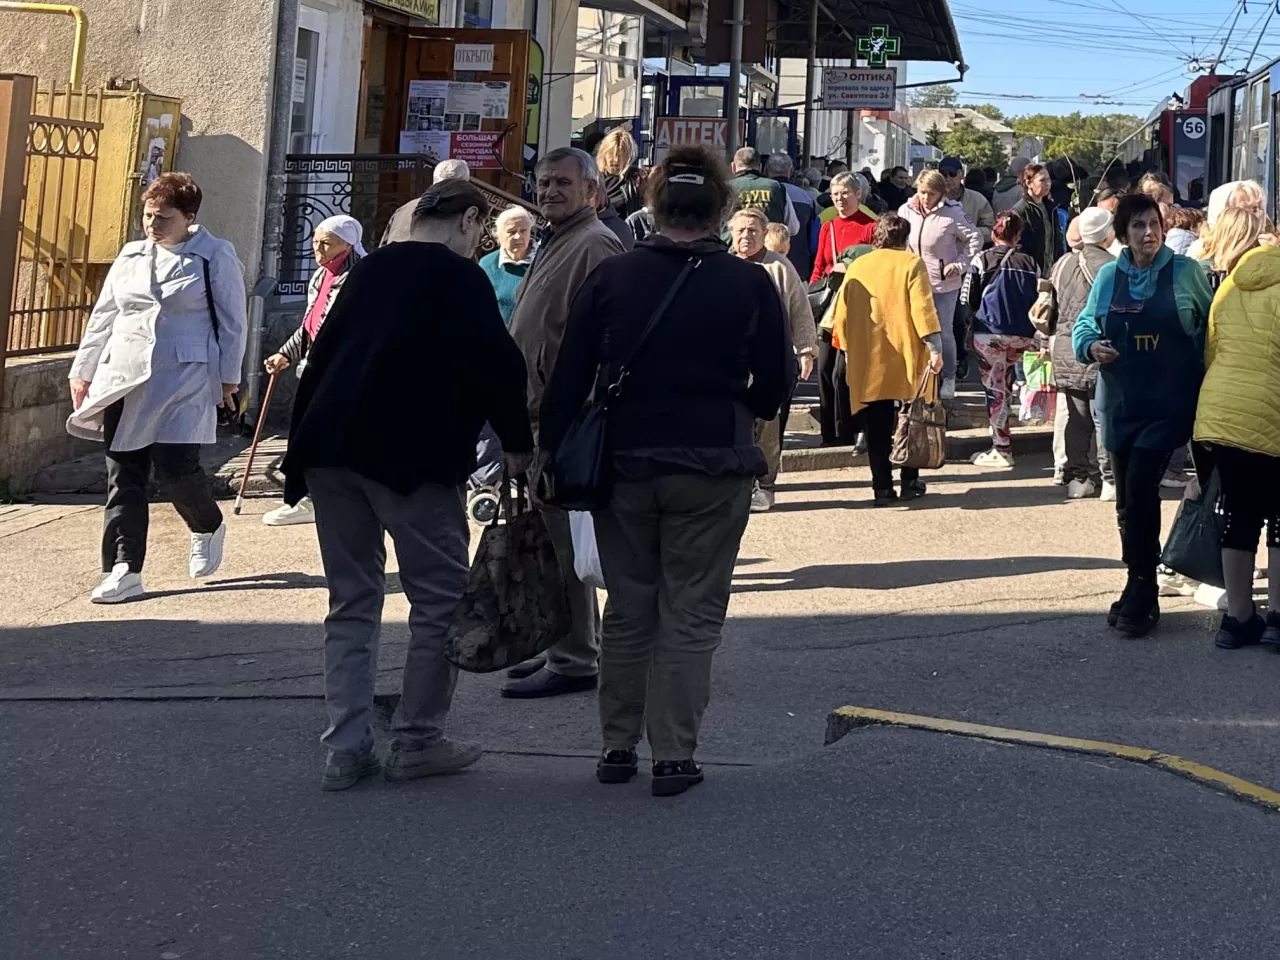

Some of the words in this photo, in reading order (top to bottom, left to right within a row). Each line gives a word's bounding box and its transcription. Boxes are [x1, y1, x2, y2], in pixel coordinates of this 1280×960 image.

[455, 49, 493, 63] ОТКРЫТО
[849, 73, 892, 81] ОПТИКА
[1185, 121, 1204, 134] 56
[1133, 334, 1161, 352] ТТУ
